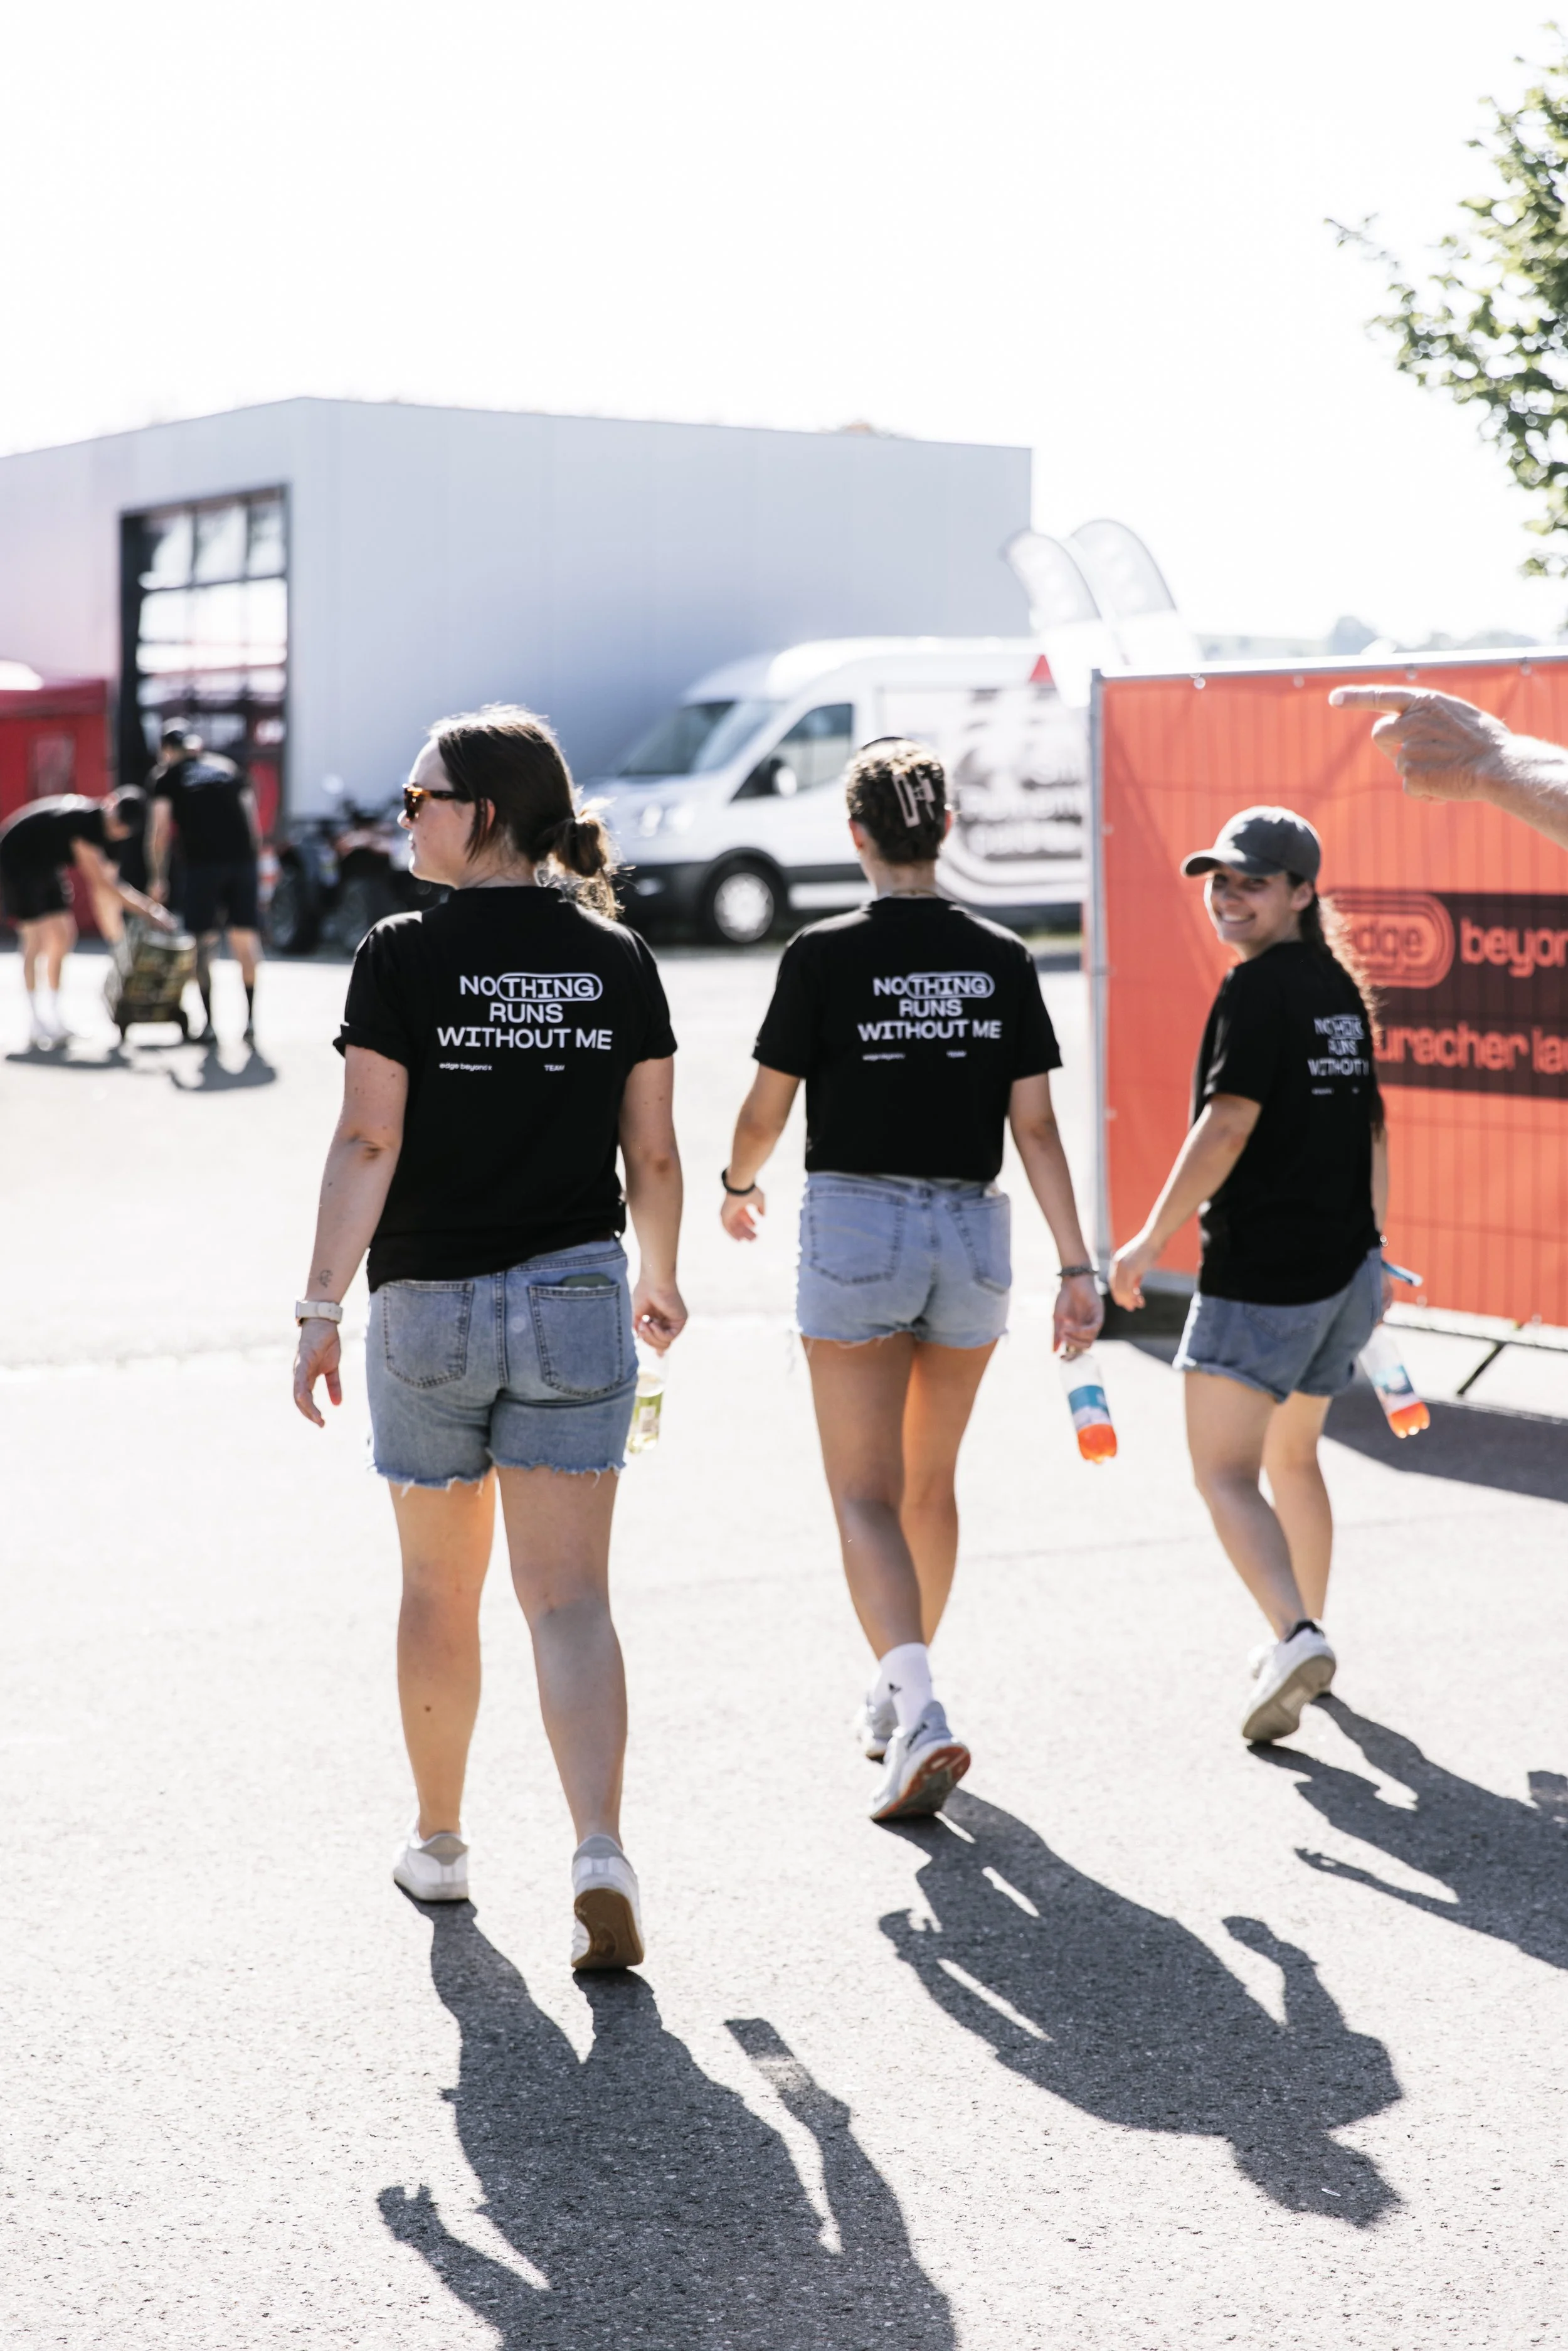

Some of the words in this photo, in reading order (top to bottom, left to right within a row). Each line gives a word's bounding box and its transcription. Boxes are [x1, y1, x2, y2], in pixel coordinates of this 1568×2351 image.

[1352, 918, 1425, 972] dge
[460, 974, 595, 999] NOTHING
[872, 976, 987, 997] NOTHING
[489, 1002, 564, 1024] RUNS
[899, 998, 963, 1018] RUNS
[437, 1026, 572, 1049] WITHOUT
[575, 1028, 613, 1050] ME
[857, 1019, 970, 1042] WITHOUT
[972, 1020, 1003, 1039] ME
